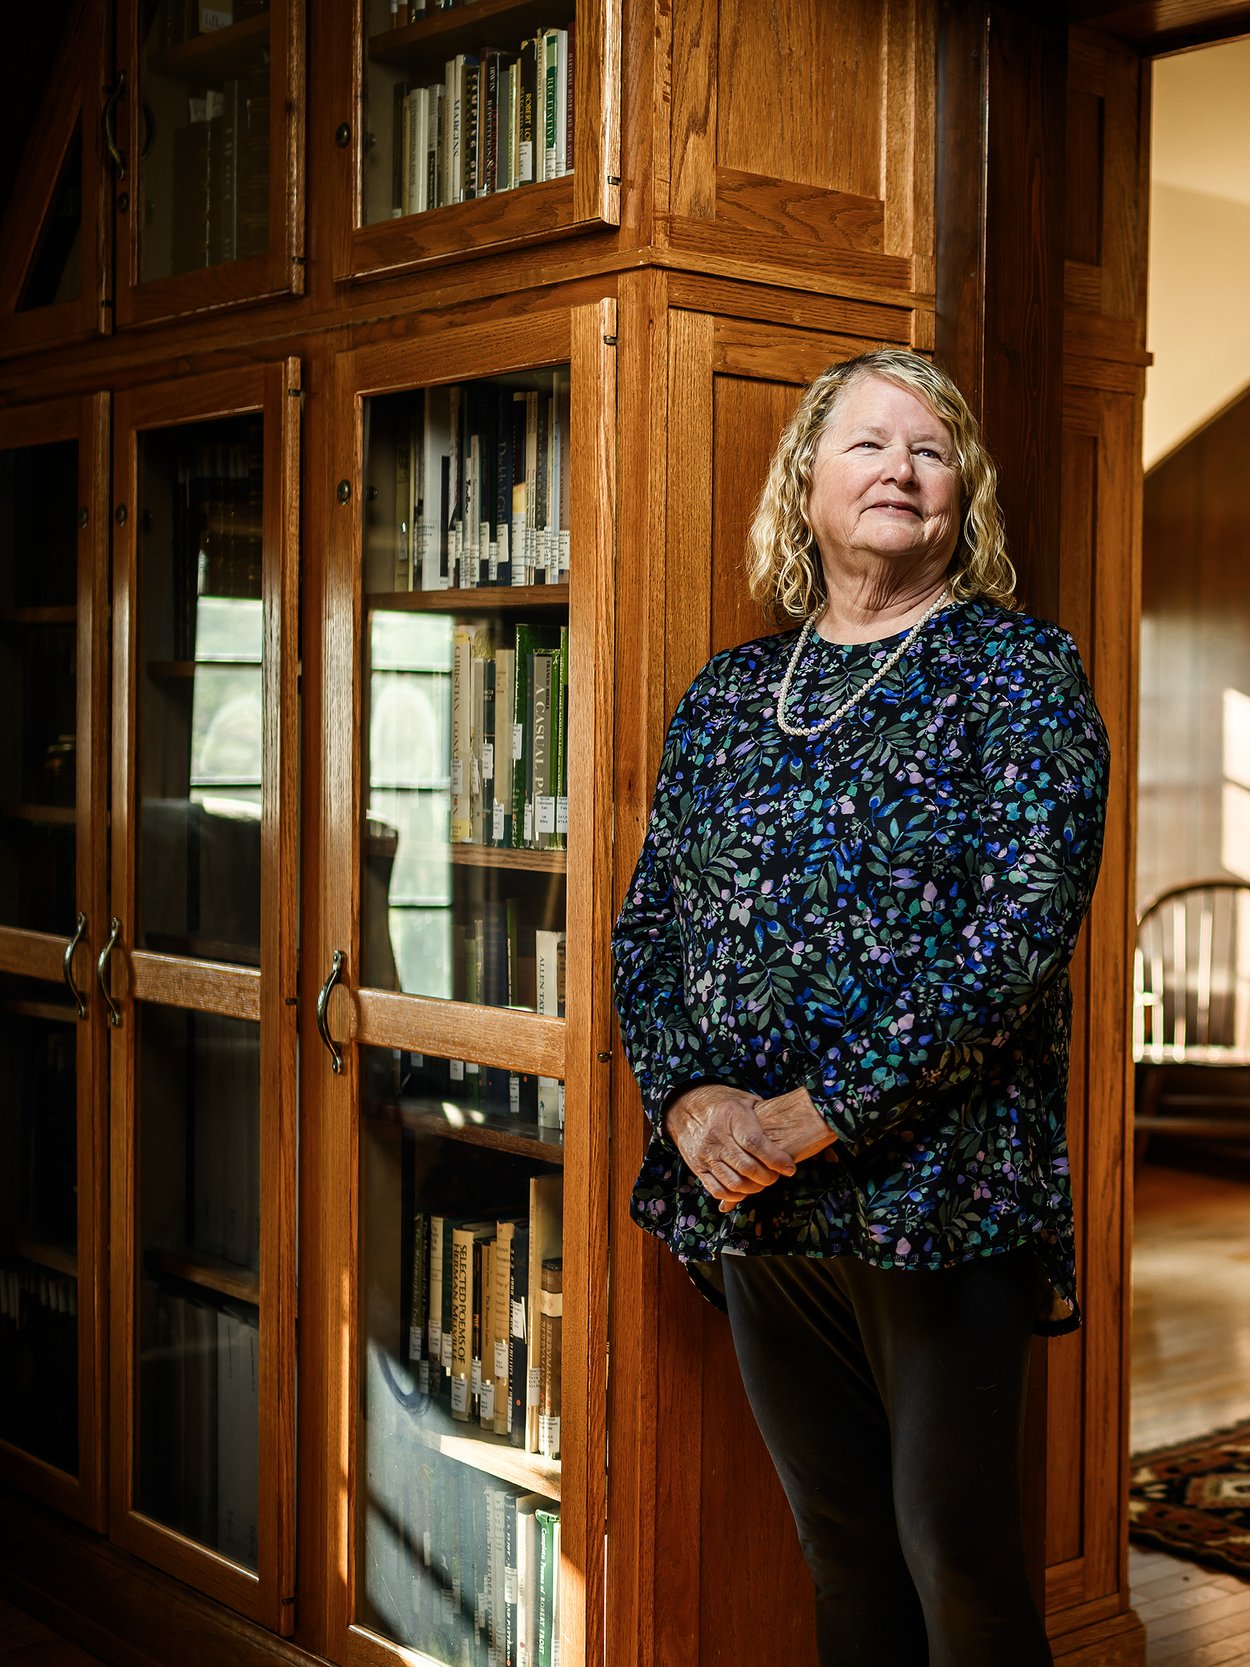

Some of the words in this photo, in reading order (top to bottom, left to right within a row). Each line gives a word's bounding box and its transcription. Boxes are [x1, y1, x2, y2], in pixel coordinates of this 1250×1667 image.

[453, 99, 461, 158] MARGINS
[470, 73, 478, 148] CAMPING
[524, 92, 533, 125] ROBERT
[546, 76, 555, 146] RECITATIVE
[469, 159, 477, 191] OUT
[453, 645, 461, 712] CHRISTIAN
[536, 683, 545, 696] A
[535, 701, 545, 770] CASUAL
[453, 1242, 461, 1302] HERMAN
[459, 1244, 469, 1302] SELECTED
[451, 1303, 460, 1362] MELVILLE
[458, 1304, 467, 1346] POEMS
[457, 1348, 466, 1365] OF
[540, 1585, 546, 1595] of
